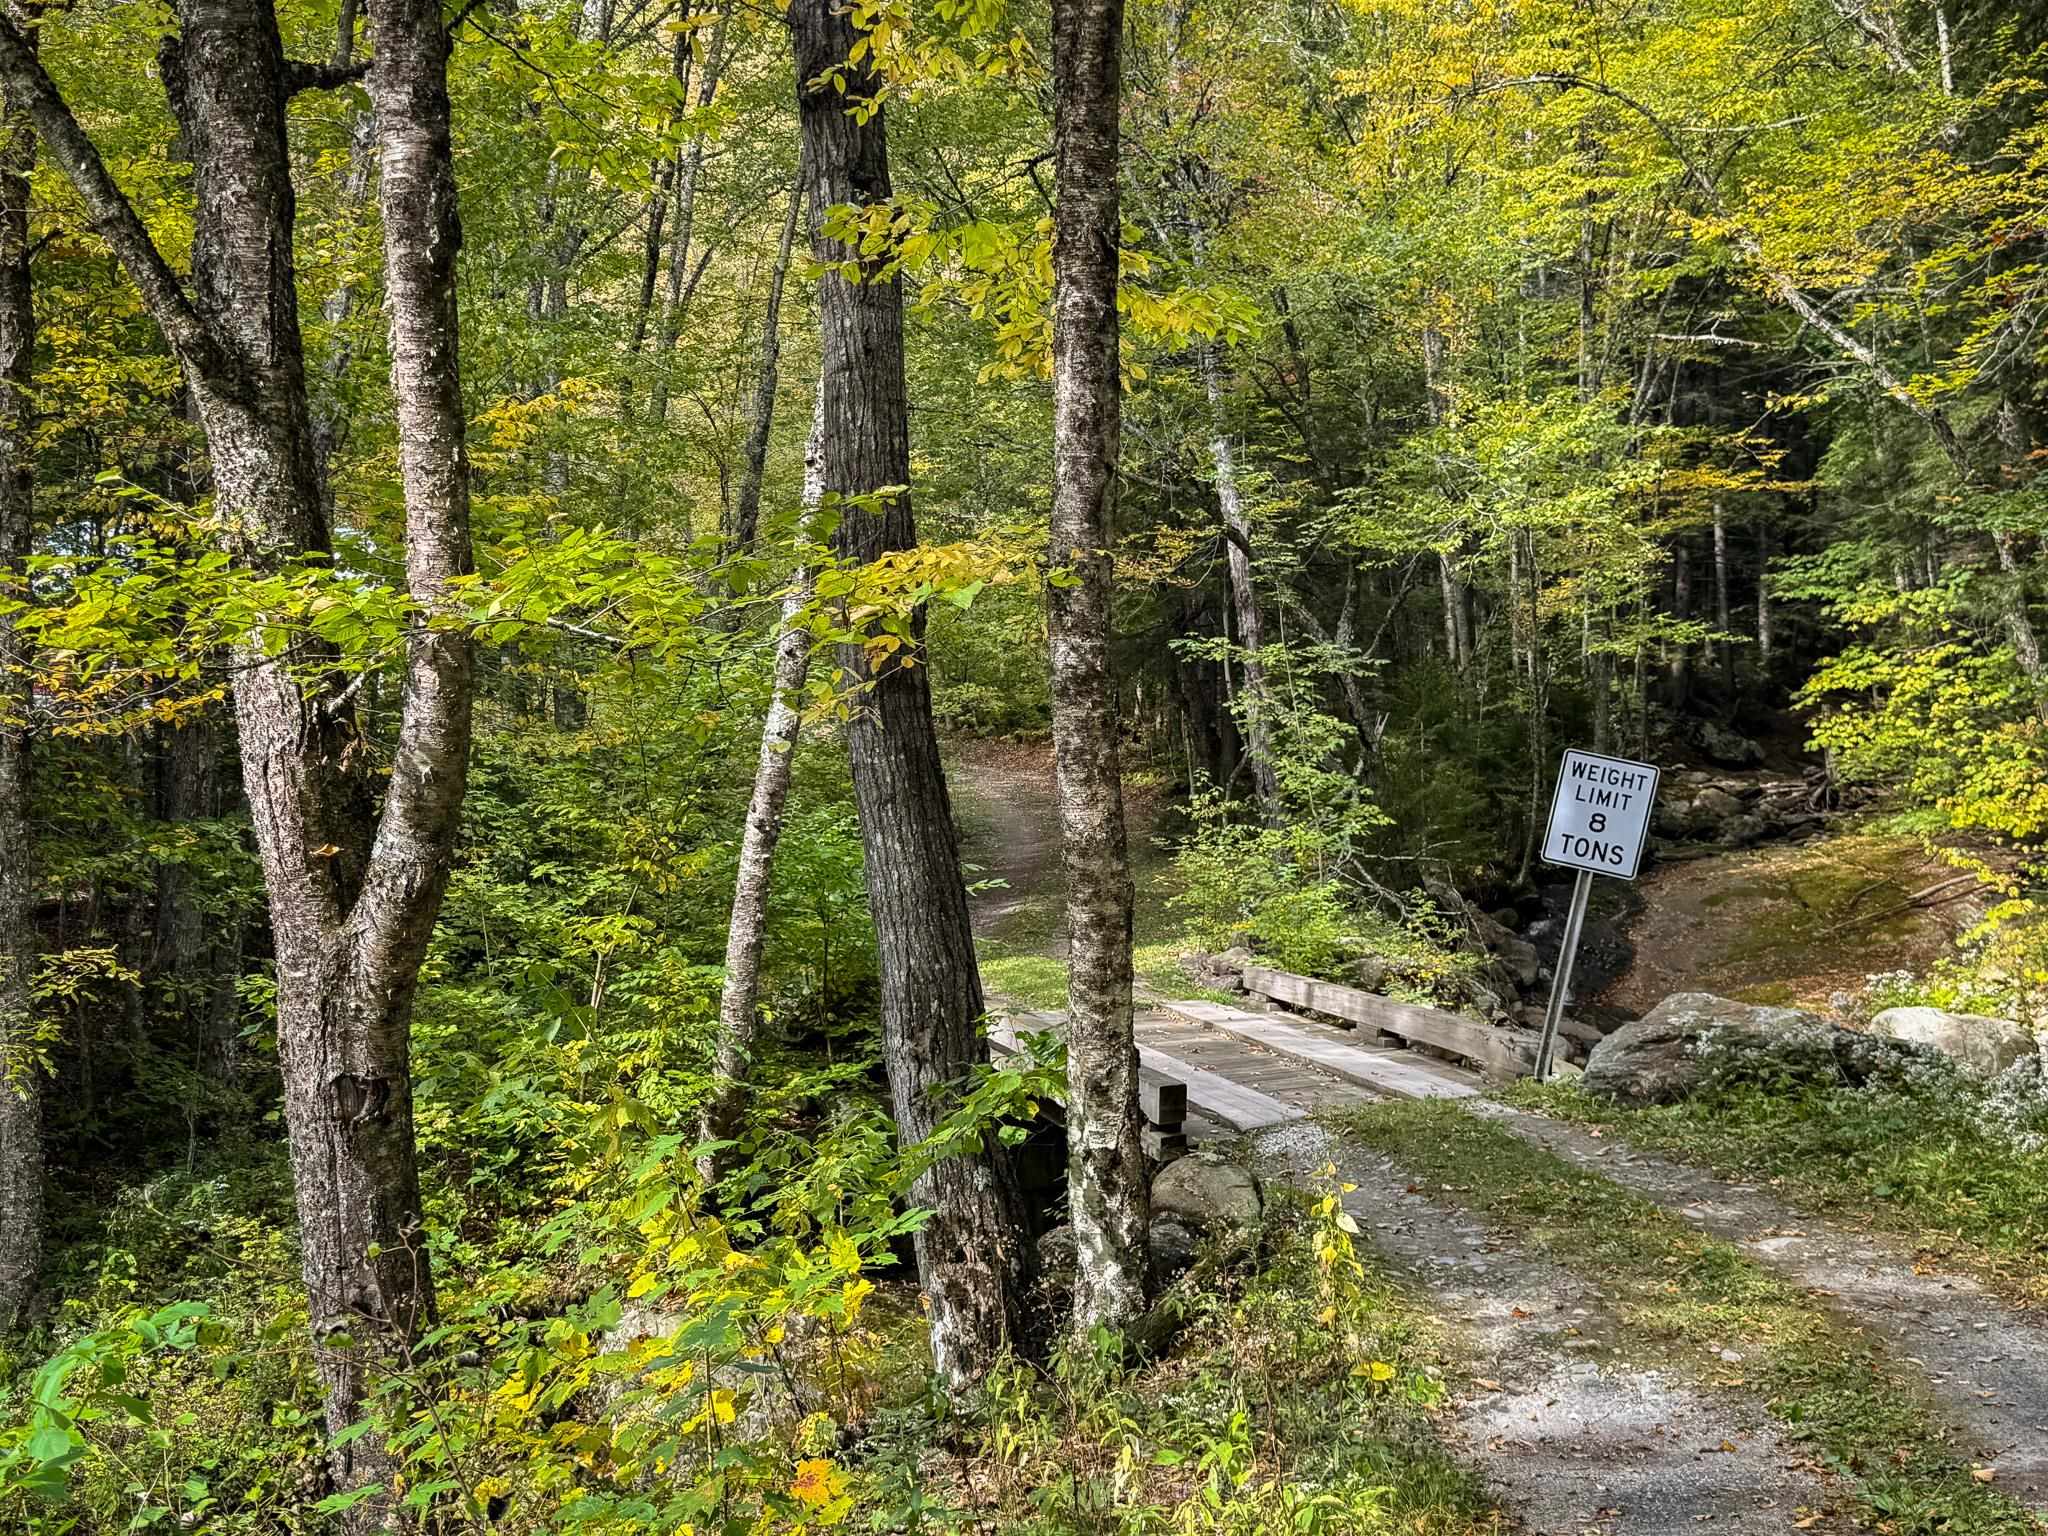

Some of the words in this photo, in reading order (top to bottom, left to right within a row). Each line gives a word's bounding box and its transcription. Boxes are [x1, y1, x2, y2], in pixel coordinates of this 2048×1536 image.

[1571, 760, 1648, 791] WEIGHT
[1575, 784, 1632, 811] LIMIT
[1588, 812, 1607, 833] 8
[1561, 833, 1625, 865] TONS
